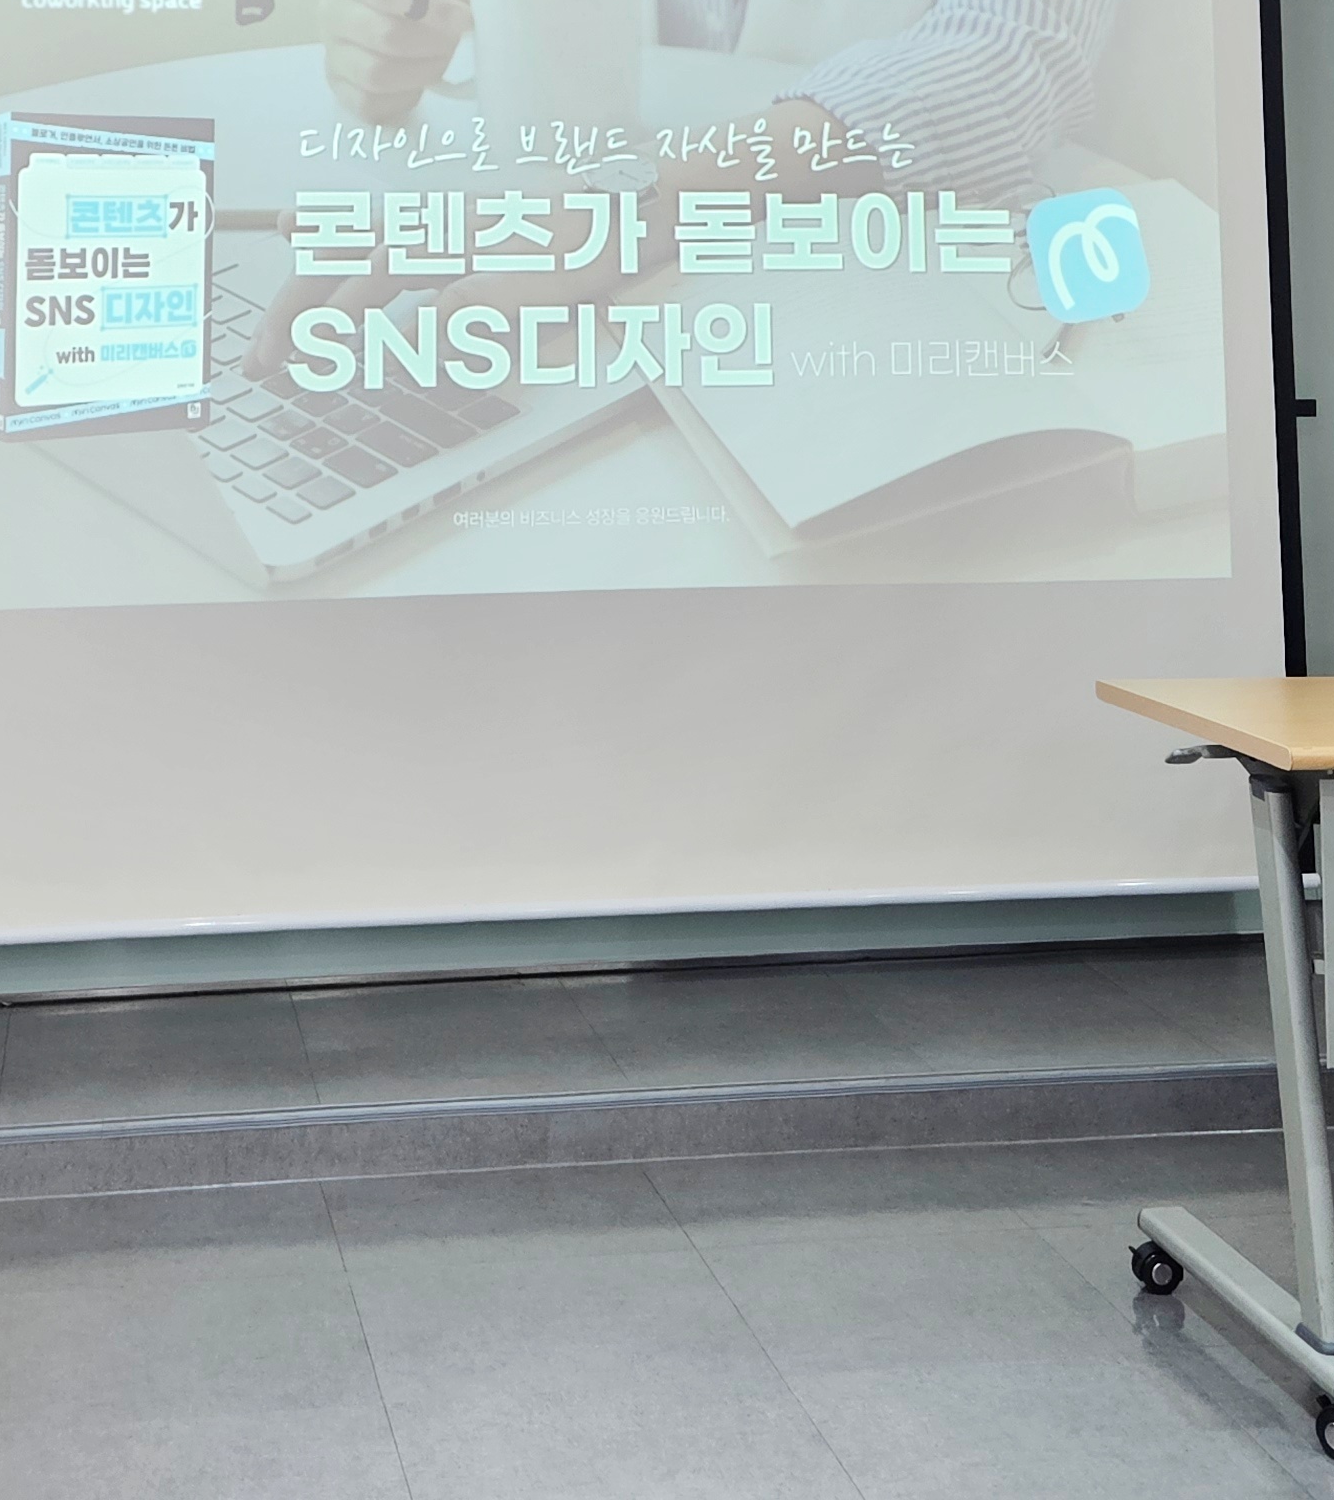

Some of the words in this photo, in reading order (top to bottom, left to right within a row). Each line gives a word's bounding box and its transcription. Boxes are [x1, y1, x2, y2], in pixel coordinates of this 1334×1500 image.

[299, 116, 499, 172] 디자인으로
[515, 118, 639, 174] 브랜드
[655, 116, 779, 182] 자산을
[793, 121, 916, 172] 만드는
[70, 199, 199, 233] 콘텐츠가
[290, 190, 648, 276] 콘텐츠가
[673, 190, 1015, 275] 돋보이는
[25, 247, 151, 281] 돋보이는
[24, 294, 96, 328] SNS
[105, 290, 193, 324] 디자인
[56, 346, 96, 364] with
[286, 302, 775, 393] SNS디자인
[790, 341, 877, 378] with
[889, 339, 1076, 378] 미리캔버스
[453, 509, 515, 529] 여러분의
[519, 508, 583, 528] 비즈니스
[585, 507, 631, 527] 성장을
[635, 504, 731, 526] 응원드립니다.
